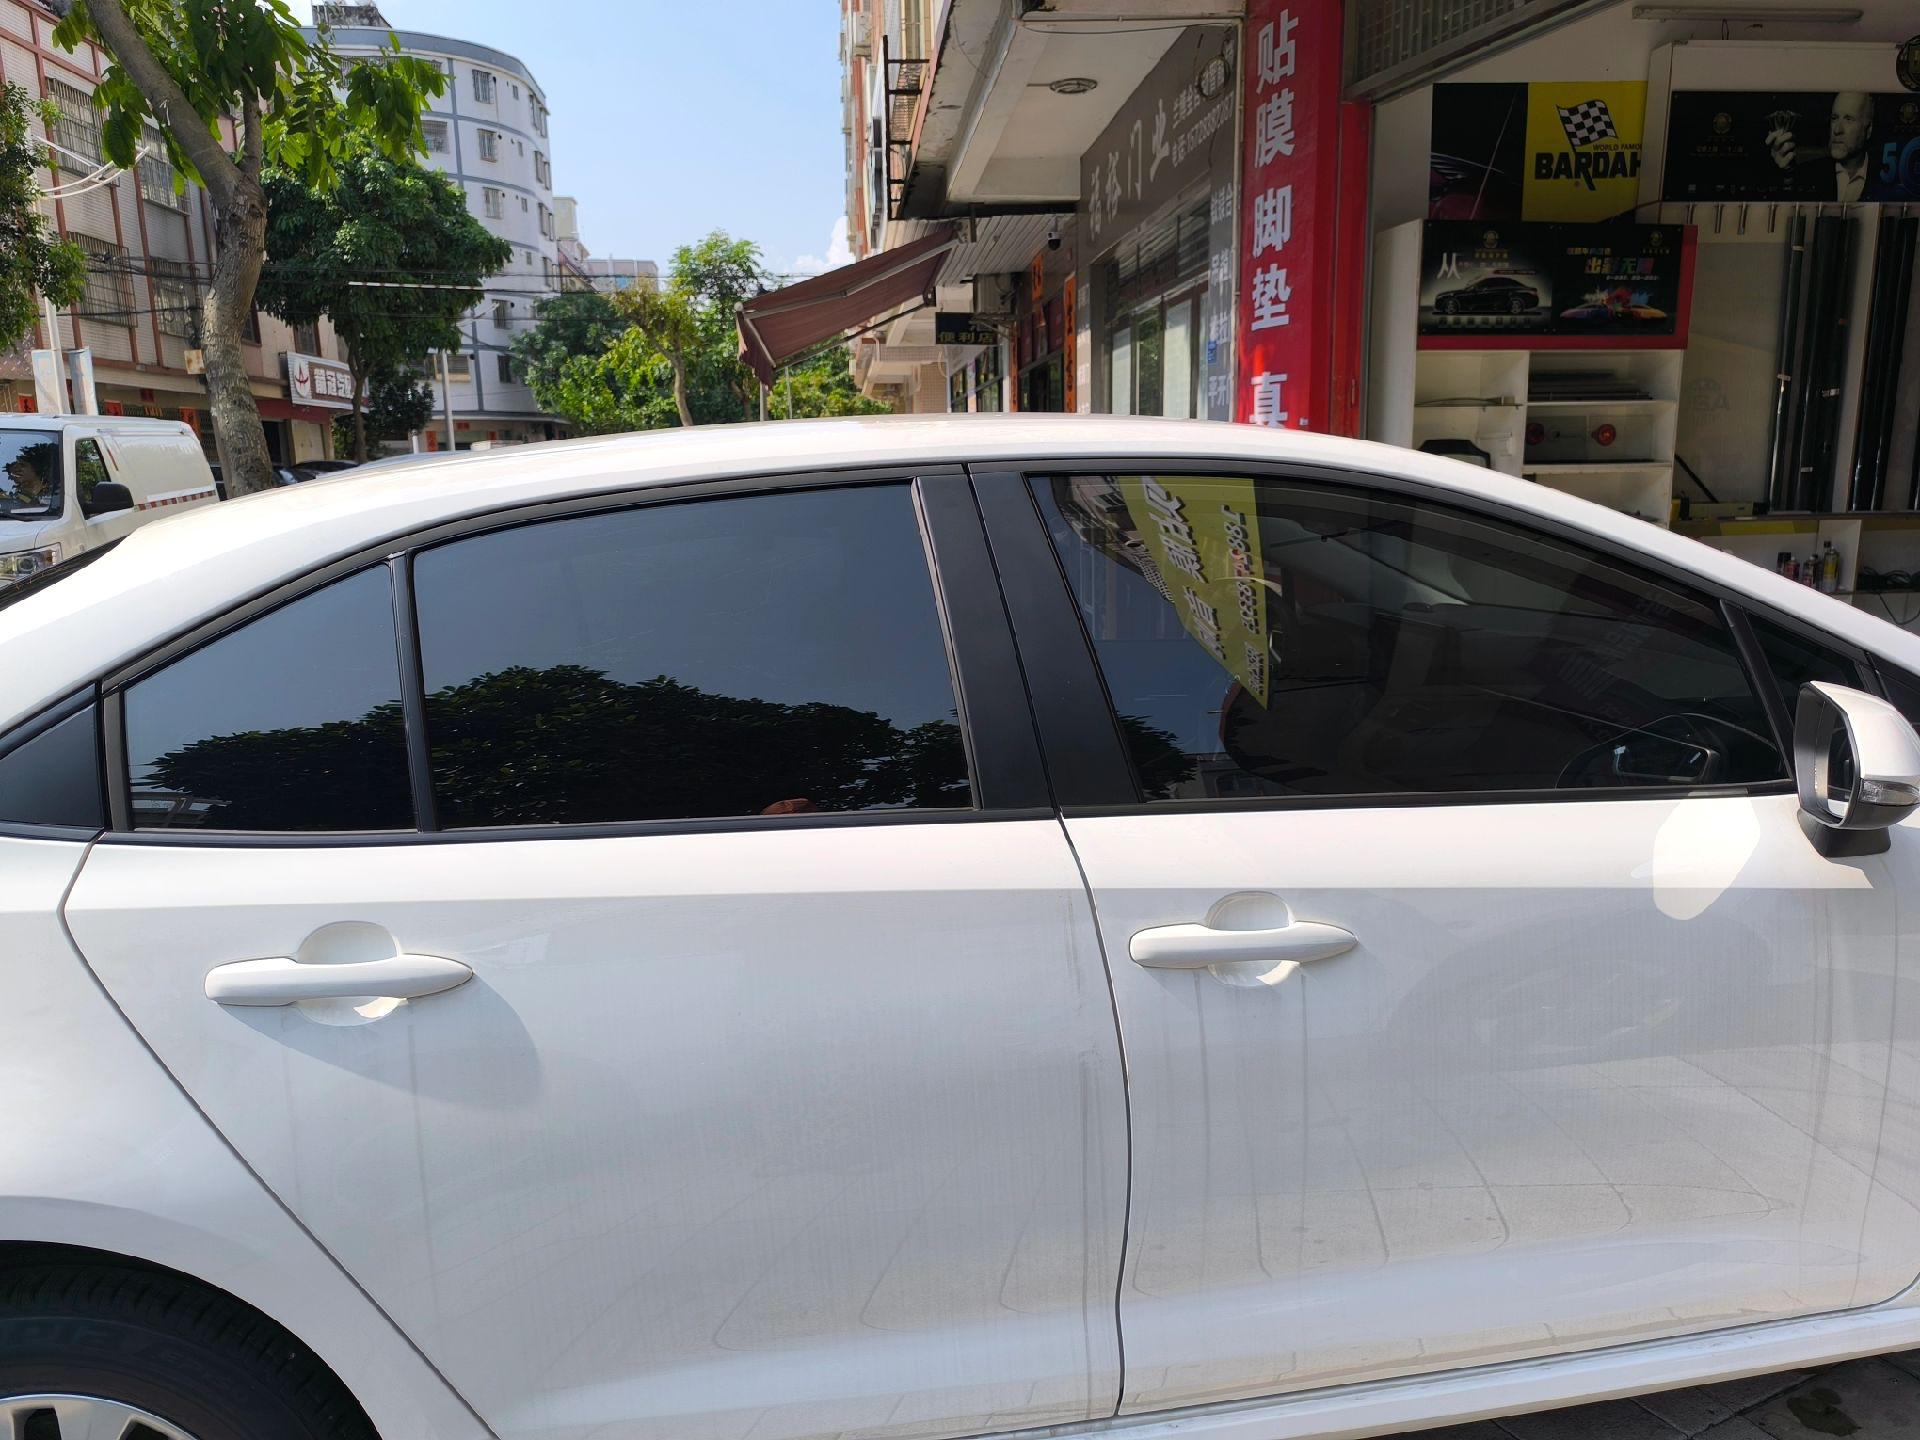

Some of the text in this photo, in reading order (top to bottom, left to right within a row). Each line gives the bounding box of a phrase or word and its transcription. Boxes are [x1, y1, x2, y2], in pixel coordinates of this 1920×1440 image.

[1256, 8, 1299, 169] 贴膜
[1593, 143, 1618, 151] WORLD
[1534, 151, 1642, 191] BARDAH
[1251, 184, 1293, 332] 脚垫
[1436, 252, 1461, 279] 从
[939, 332, 993, 344] 便利店
